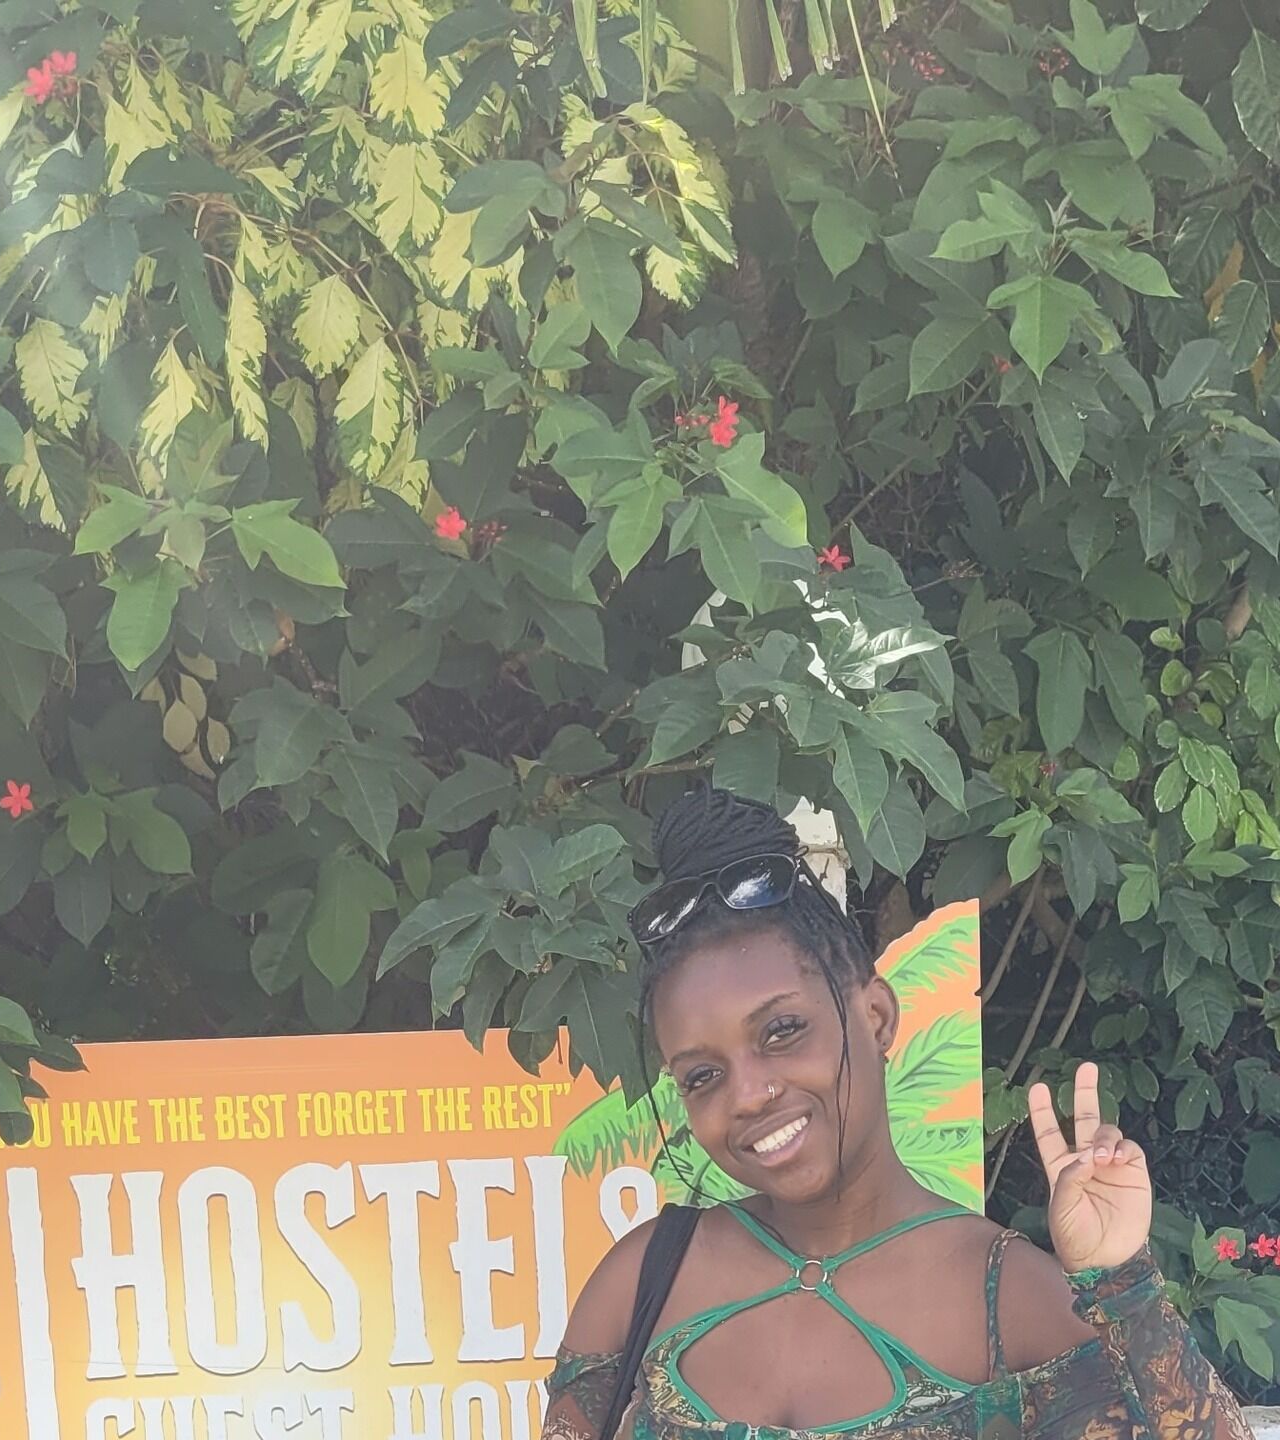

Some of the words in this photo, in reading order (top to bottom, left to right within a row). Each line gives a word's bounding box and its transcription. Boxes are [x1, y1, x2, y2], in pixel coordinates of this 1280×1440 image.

[61, 1099, 141, 1147] HAVE
[148, 1096, 206, 1144] THE
[214, 1093, 288, 1141] BEST
[297, 1089, 408, 1138] FORGET
[417, 1086, 473, 1133] THE
[482, 1082, 571, 1130] REST”
